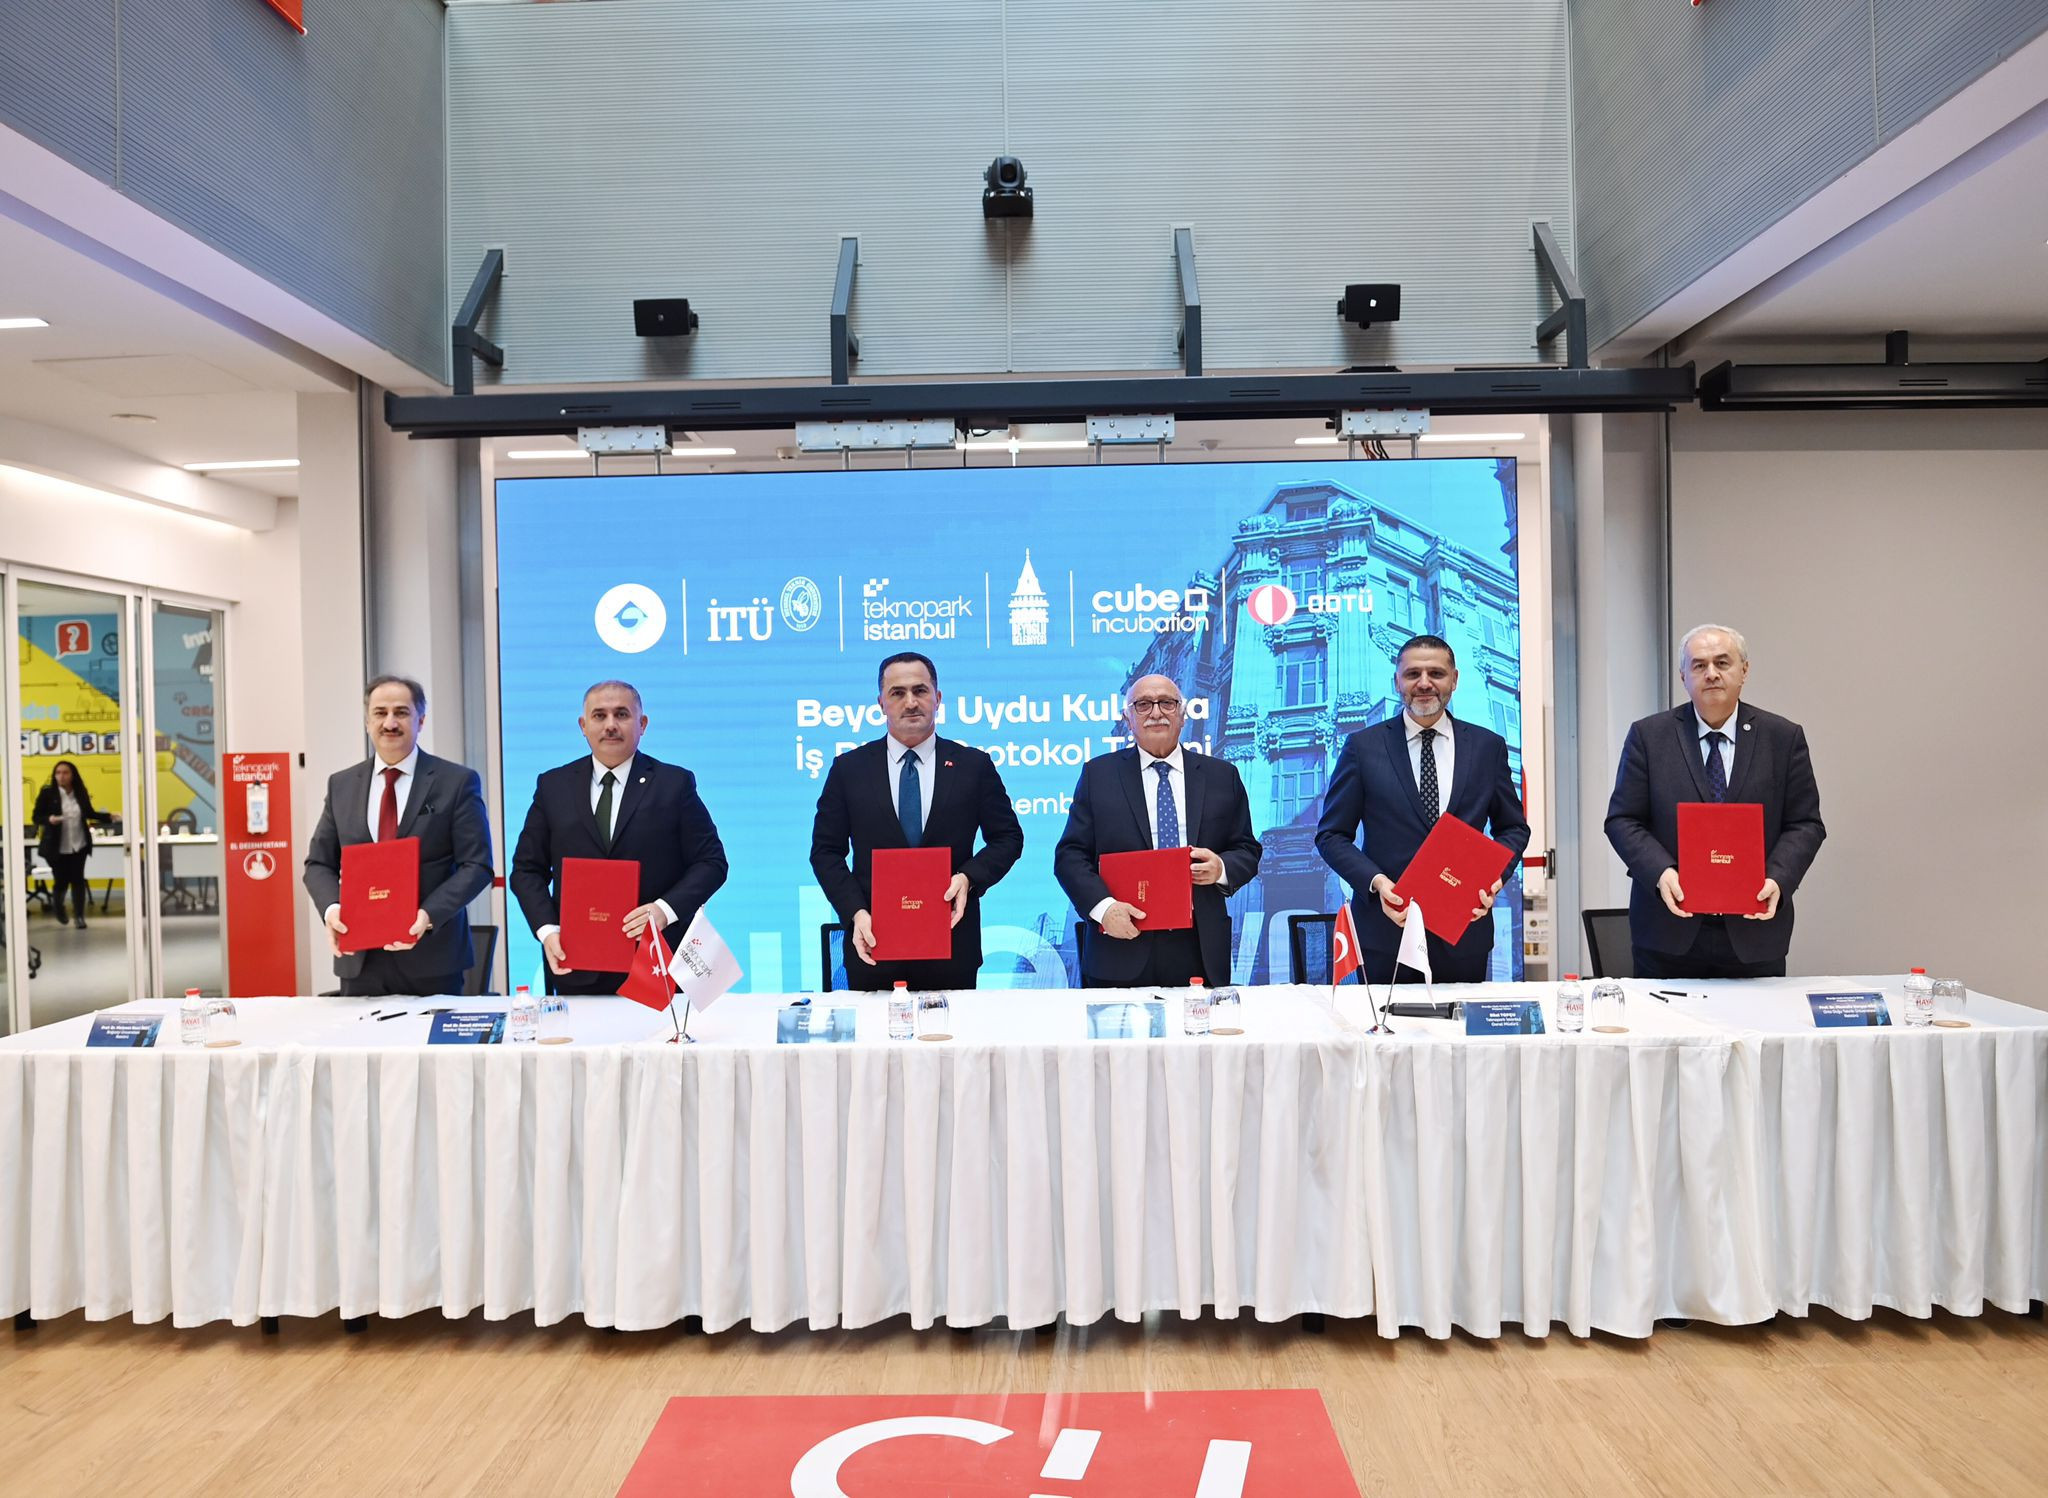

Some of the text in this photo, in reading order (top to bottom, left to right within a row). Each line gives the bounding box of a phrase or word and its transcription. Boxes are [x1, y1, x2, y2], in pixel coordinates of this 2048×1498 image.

[862, 595, 973, 622] teknopark
[1091, 583, 1179, 613] cube
[707, 597, 775, 641] İTÜ
[863, 618, 956, 641] istanbul
[1091, 611, 1209, 633] incubation
[957, 695, 1051, 730] Uydu
[796, 735, 824, 779] İş
